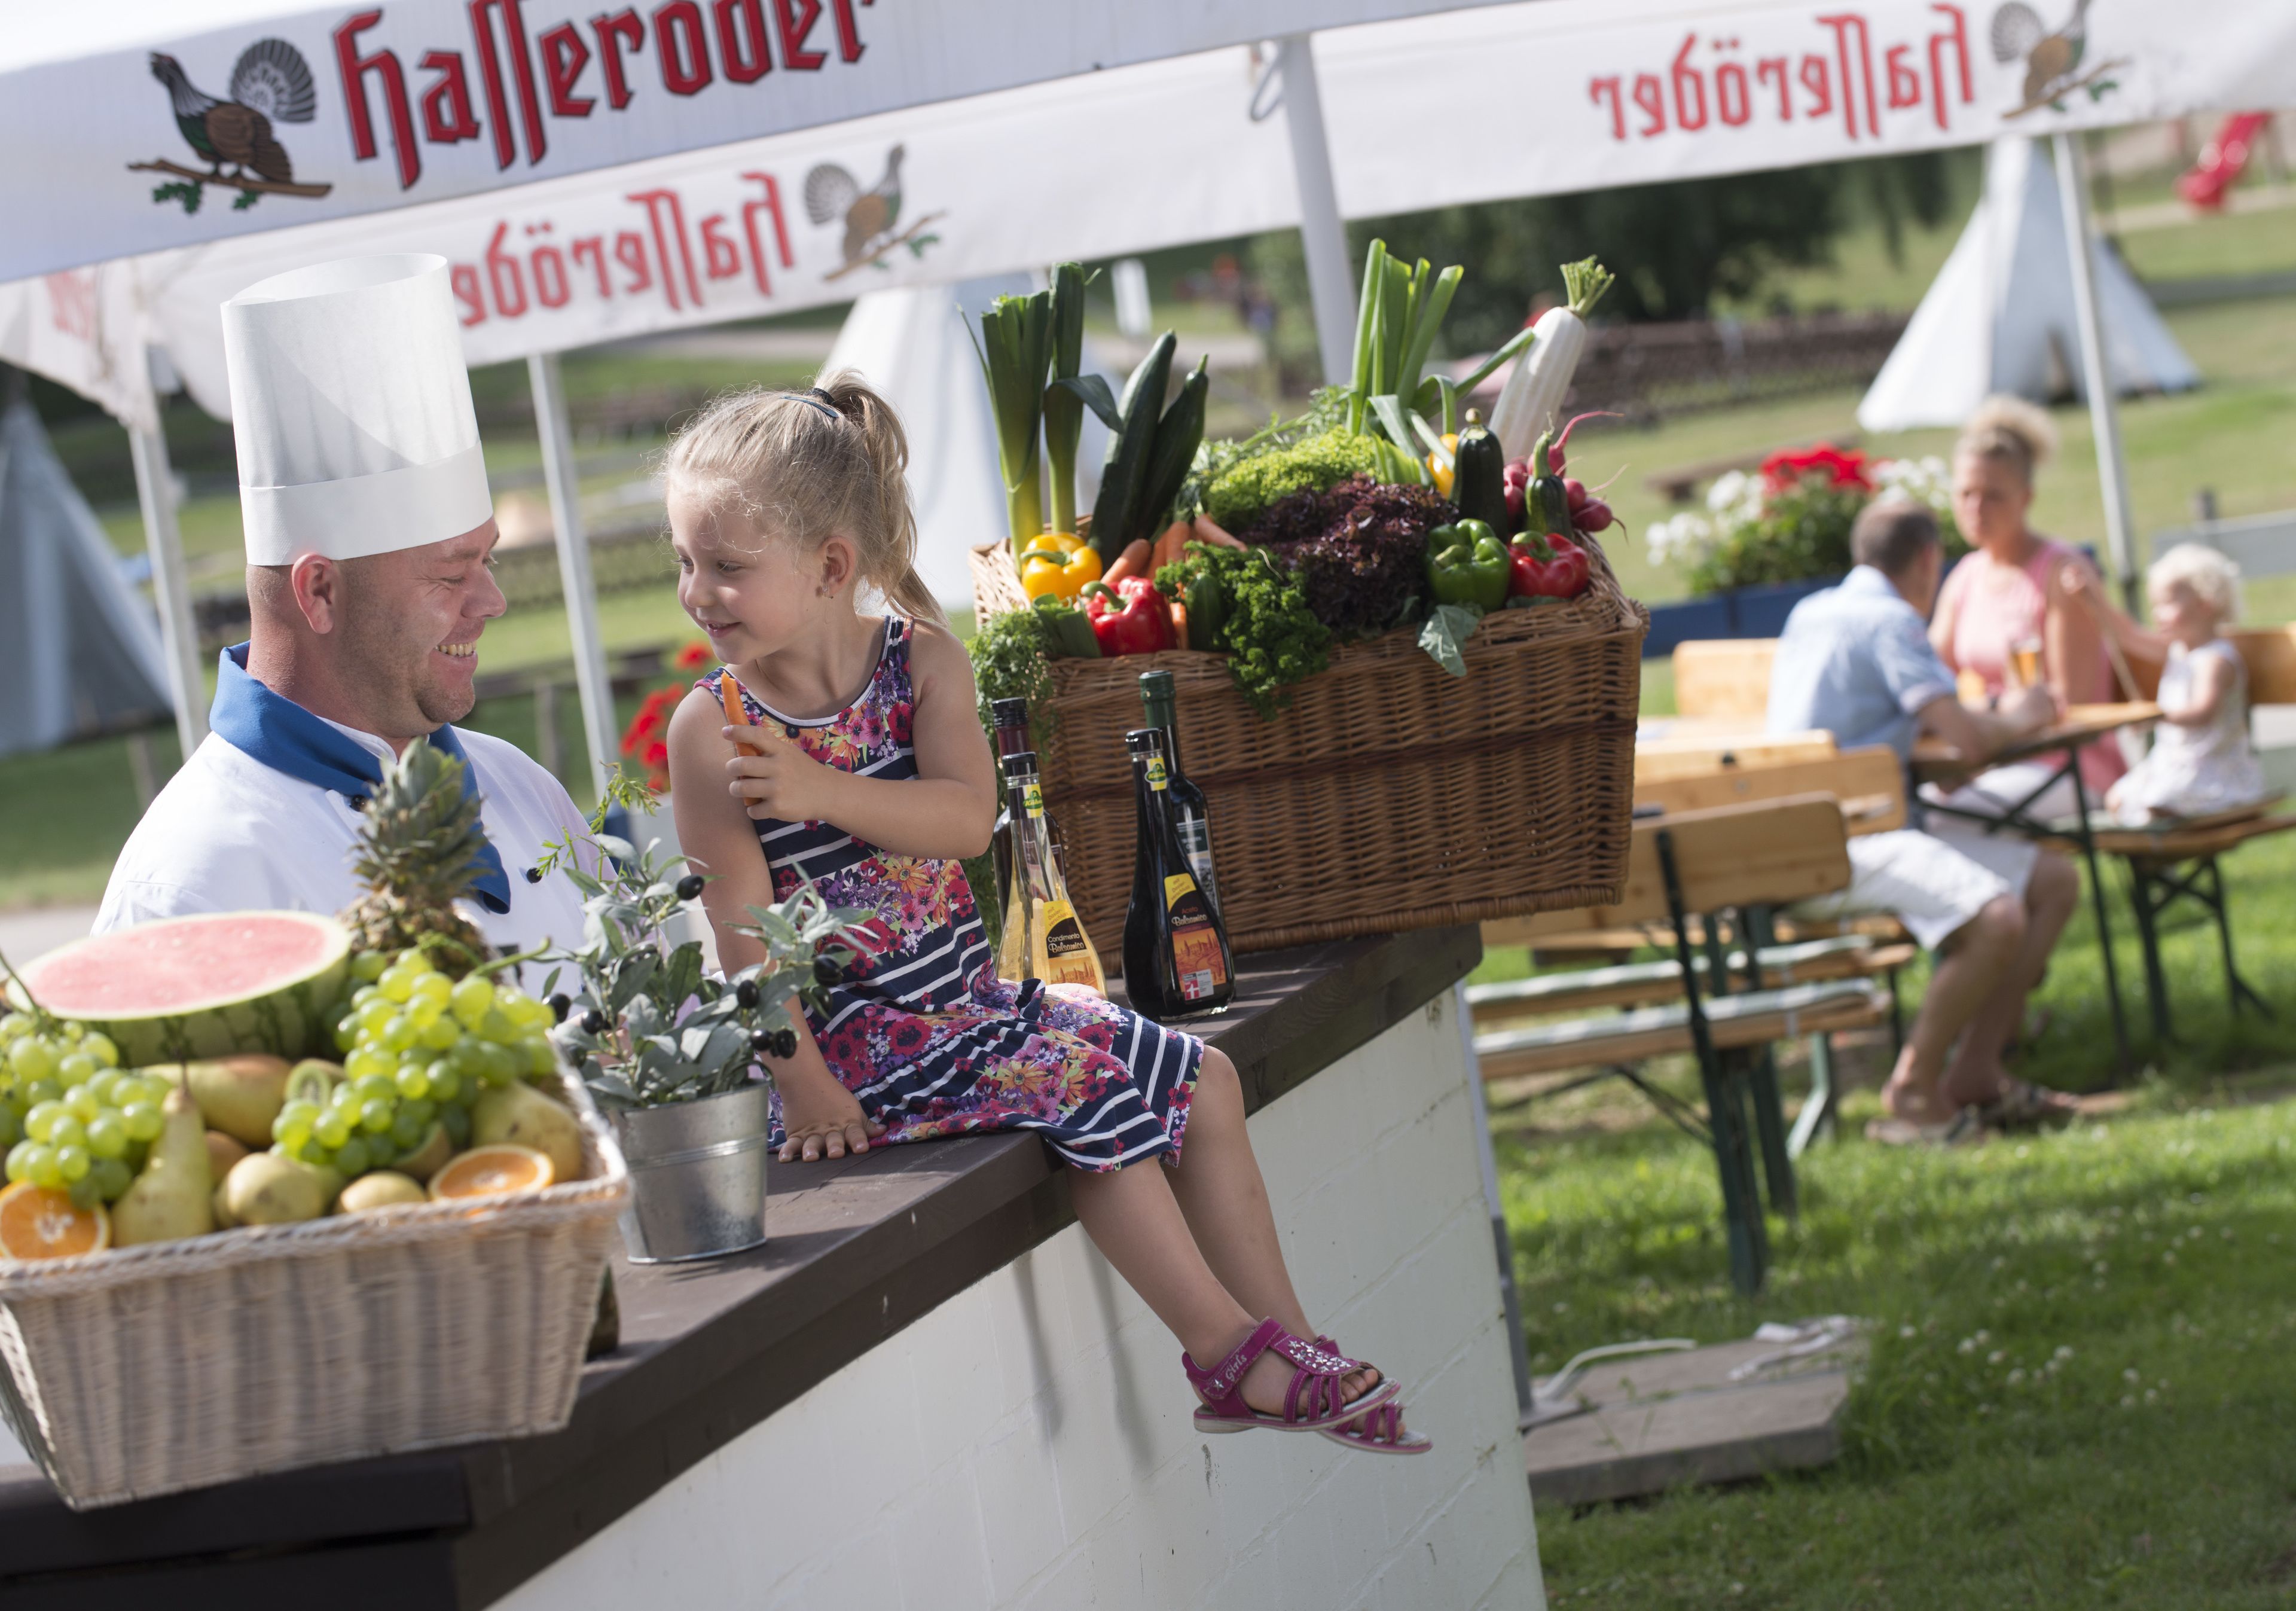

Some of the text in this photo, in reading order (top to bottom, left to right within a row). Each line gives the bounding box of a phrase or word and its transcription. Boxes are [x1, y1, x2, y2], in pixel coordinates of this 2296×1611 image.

[1181, 906, 1198, 914] Aceto
[1171, 914, 1207, 926] Balsamico
[1048, 932, 1080, 943] Condimento
[1048, 942, 1085, 953] Balsamico
[1225, 1354, 1247, 1381] Girls
